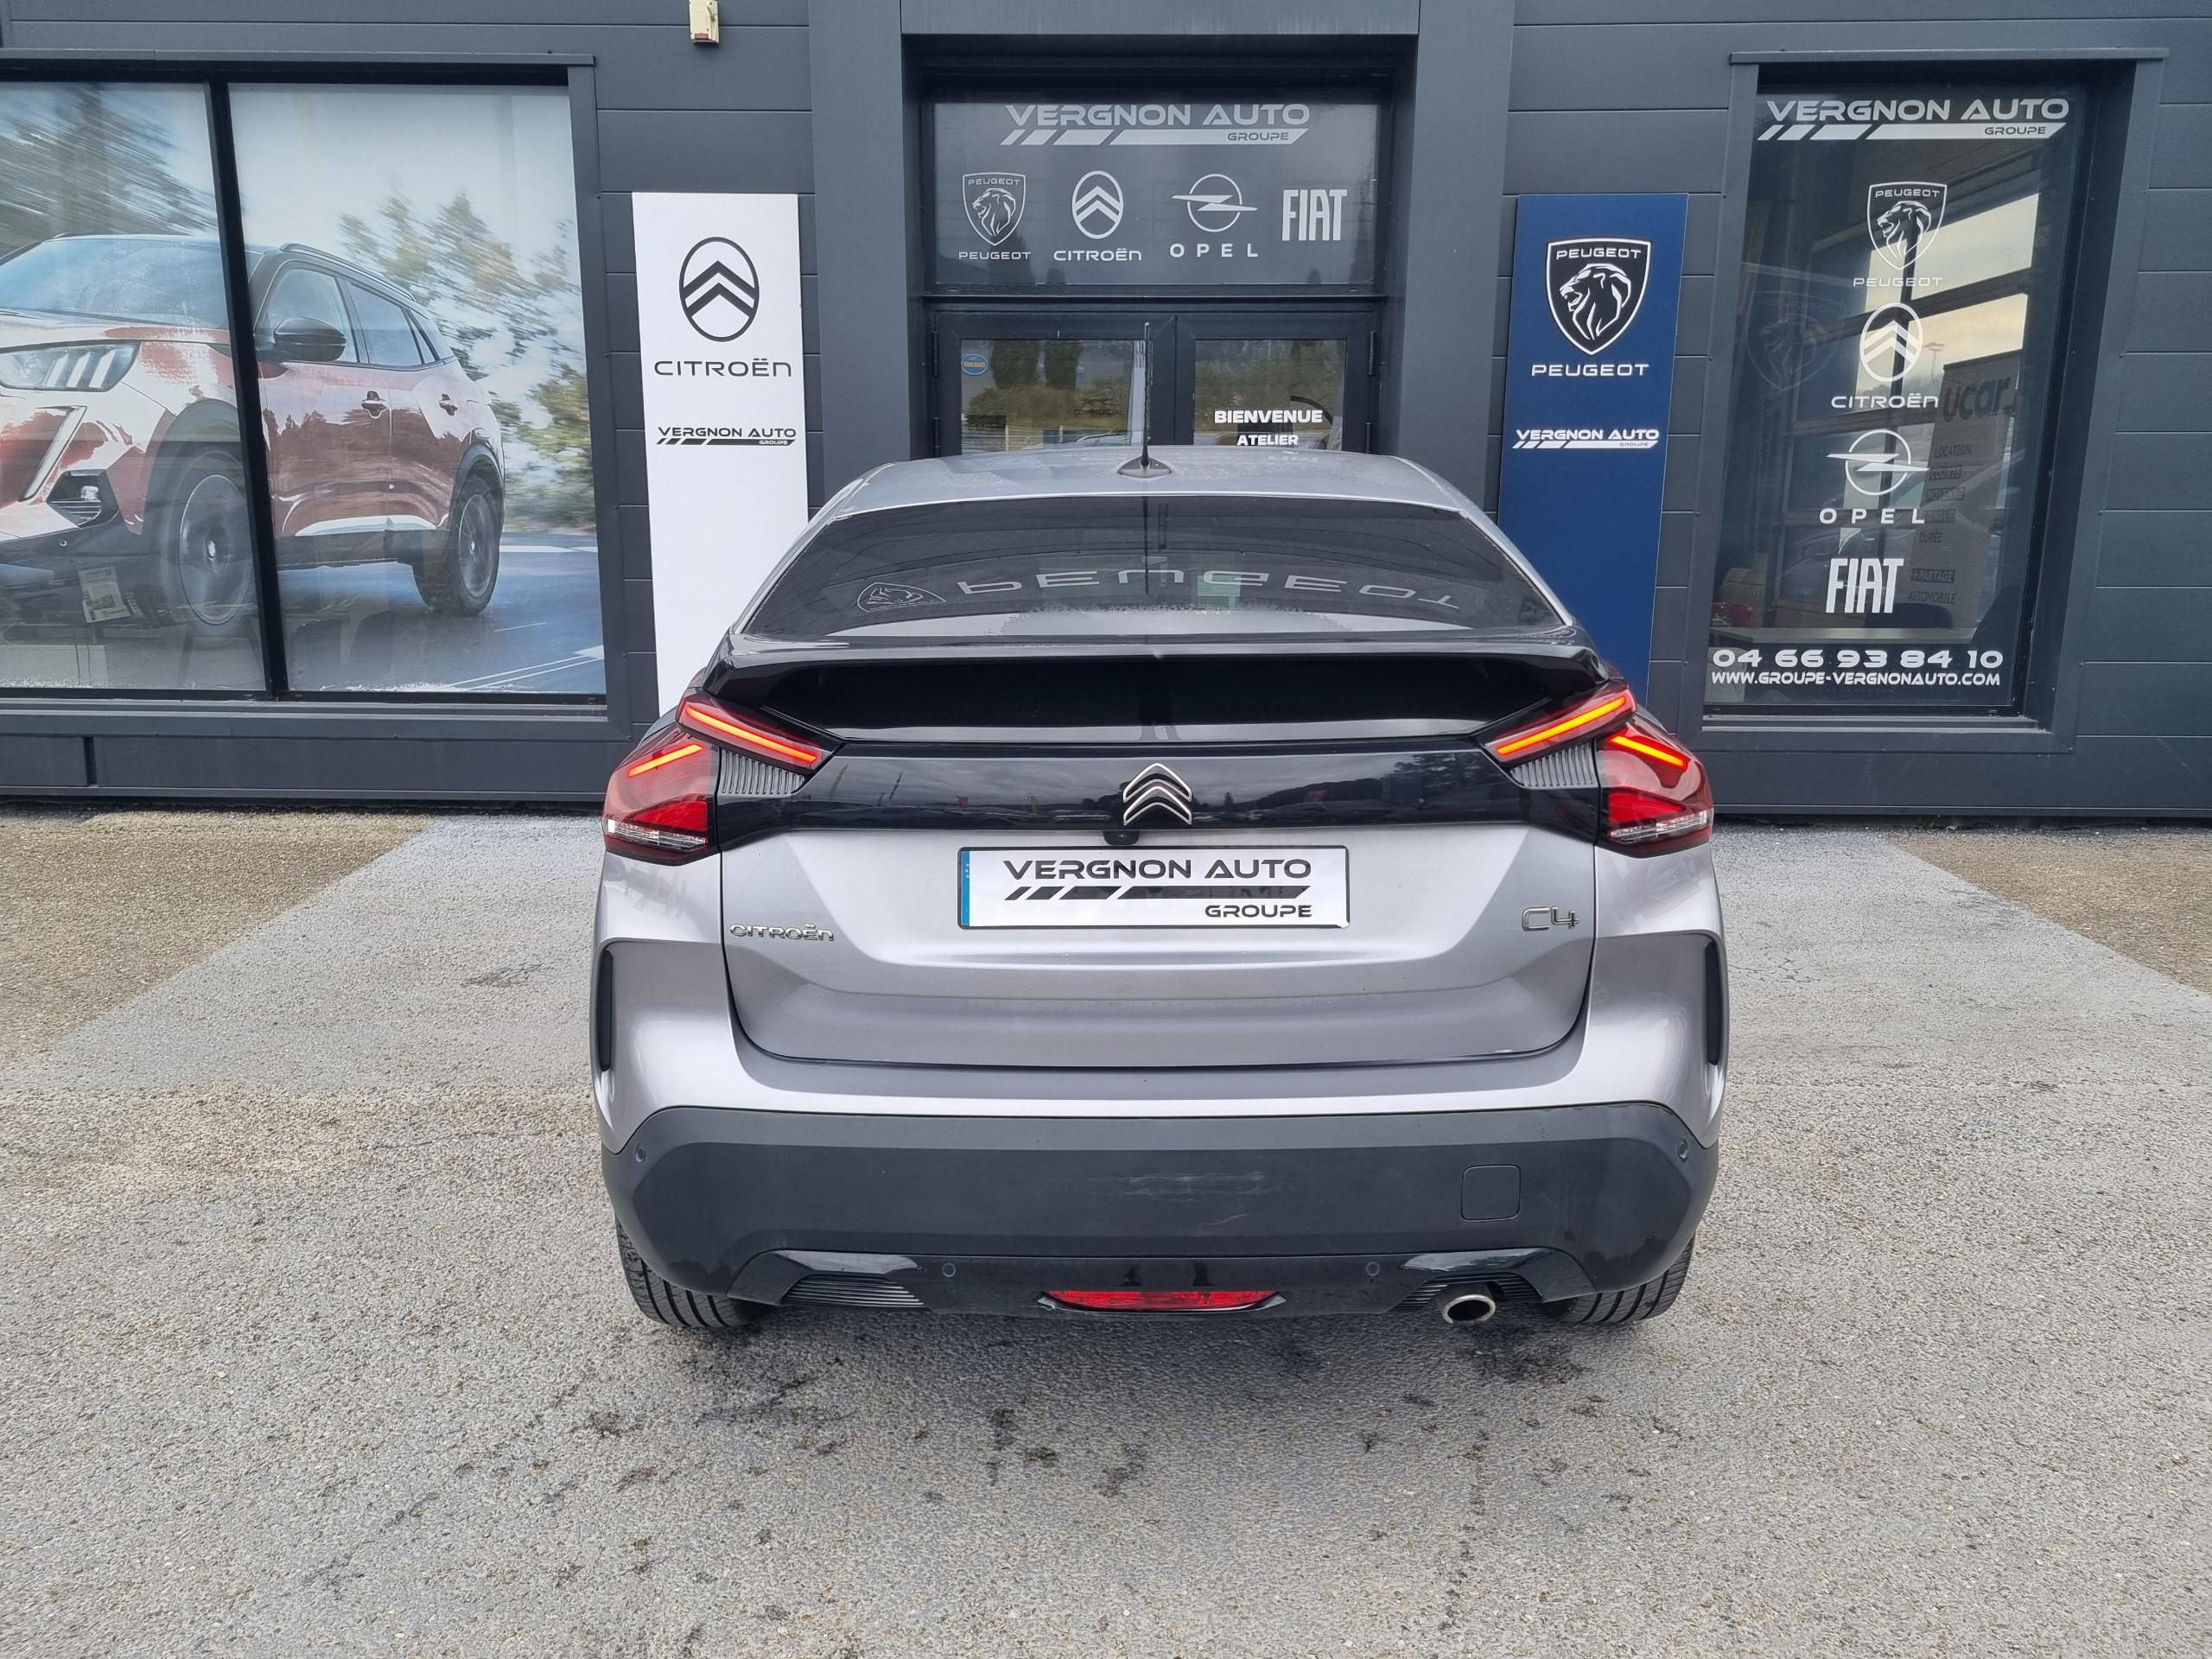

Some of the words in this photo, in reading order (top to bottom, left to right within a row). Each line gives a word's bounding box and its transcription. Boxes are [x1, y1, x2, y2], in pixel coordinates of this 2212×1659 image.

[1005, 105, 1191, 126] VERGNON
[1202, 104, 1310, 126] AUTO
[1766, 99, 1951, 121] VERGNON
[1960, 99, 2069, 120] AUTO
[1227, 132, 1290, 142] GROUPE
[1984, 126, 2046, 135] GROUPE
[968, 178, 1020, 187] PEUGEOT
[1875, 188, 1940, 199] PEUGEOT
[1281, 189, 1347, 241] FIAT
[958, 251, 1031, 260] PEUGEOT
[1169, 243, 1259, 258] OPEL
[1556, 248, 1642, 260] PEUGEOT
[1853, 277, 1943, 287] PEUGEOT
[1531, 364, 1649, 377] PEUGEOT
[1214, 410, 1323, 423] BIENVENUE
[658, 427, 742, 437] VERGNON
[747, 428, 797, 438] AUTO
[1516, 429, 1604, 441] VERGNON
[1607, 429, 1660, 441] AUTO
[1236, 435, 1299, 446] ATELIER
[1934, 444, 1972, 458] LOCATION
[1820, 508, 1925, 524] OPEL
[1826, 558, 1904, 613] FIAT
[1908, 591, 1956, 604] AUTOMOBILE
[1713, 650, 1763, 667] 04
[1775, 650, 1824, 667] 66
[1837, 650, 1888, 668] 93
[1899, 651, 1953, 668] 84
[1967, 651, 2004, 668] 10
[1712, 672, 2000, 686] WWW.GROUPE-VERGNONAUTO.COM
[1003, 859, 1192, 880] VERGNON
[1205, 859, 1312, 880] AUTO
[1205, 904, 1313, 918] GROUPE
[1522, 906, 1580, 931] C4
